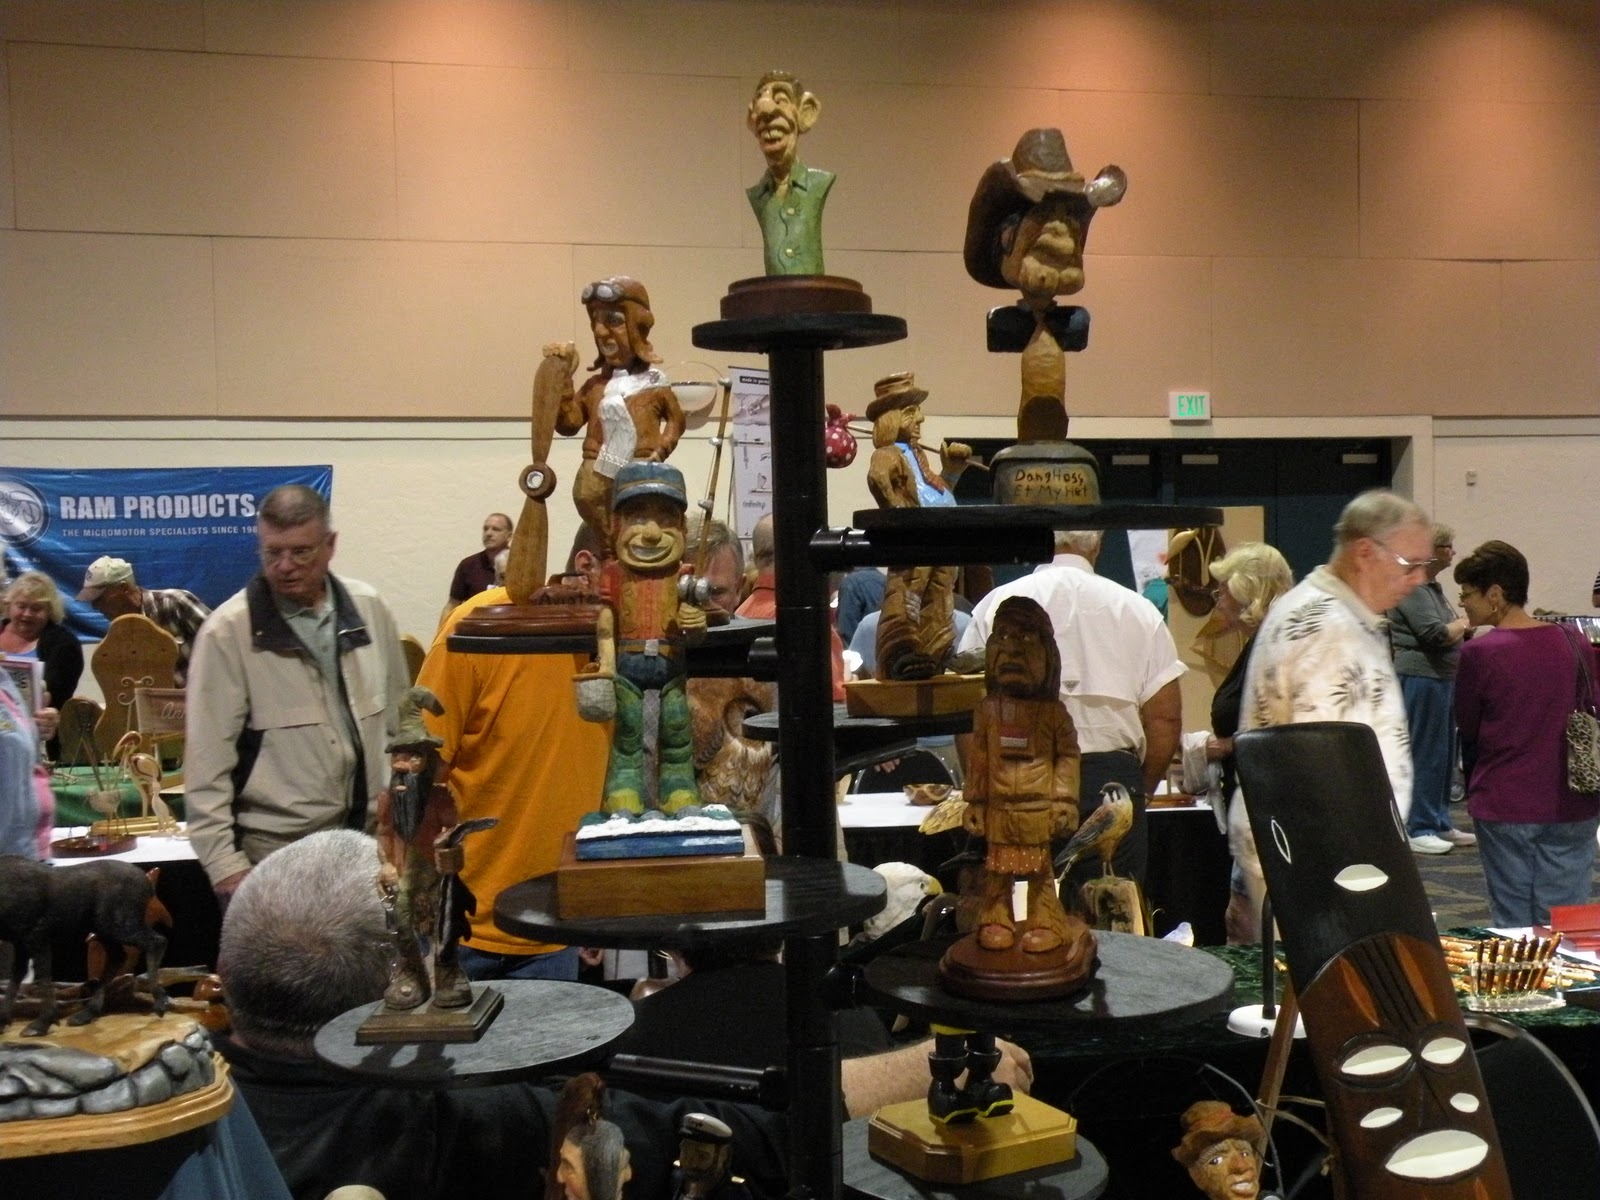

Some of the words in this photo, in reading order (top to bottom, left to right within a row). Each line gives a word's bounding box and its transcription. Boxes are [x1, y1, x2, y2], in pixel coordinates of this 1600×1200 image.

[1178, 396, 1205, 417] EXIT
[1039, 485, 1061, 499] My
[60, 496, 116, 520] RAM
[62, 529, 79, 537] THE
[83, 528, 146, 537] MICROMOTOR
[149, 527, 208, 536] SPECIALISTS
[212, 526, 239, 534] SINCE
